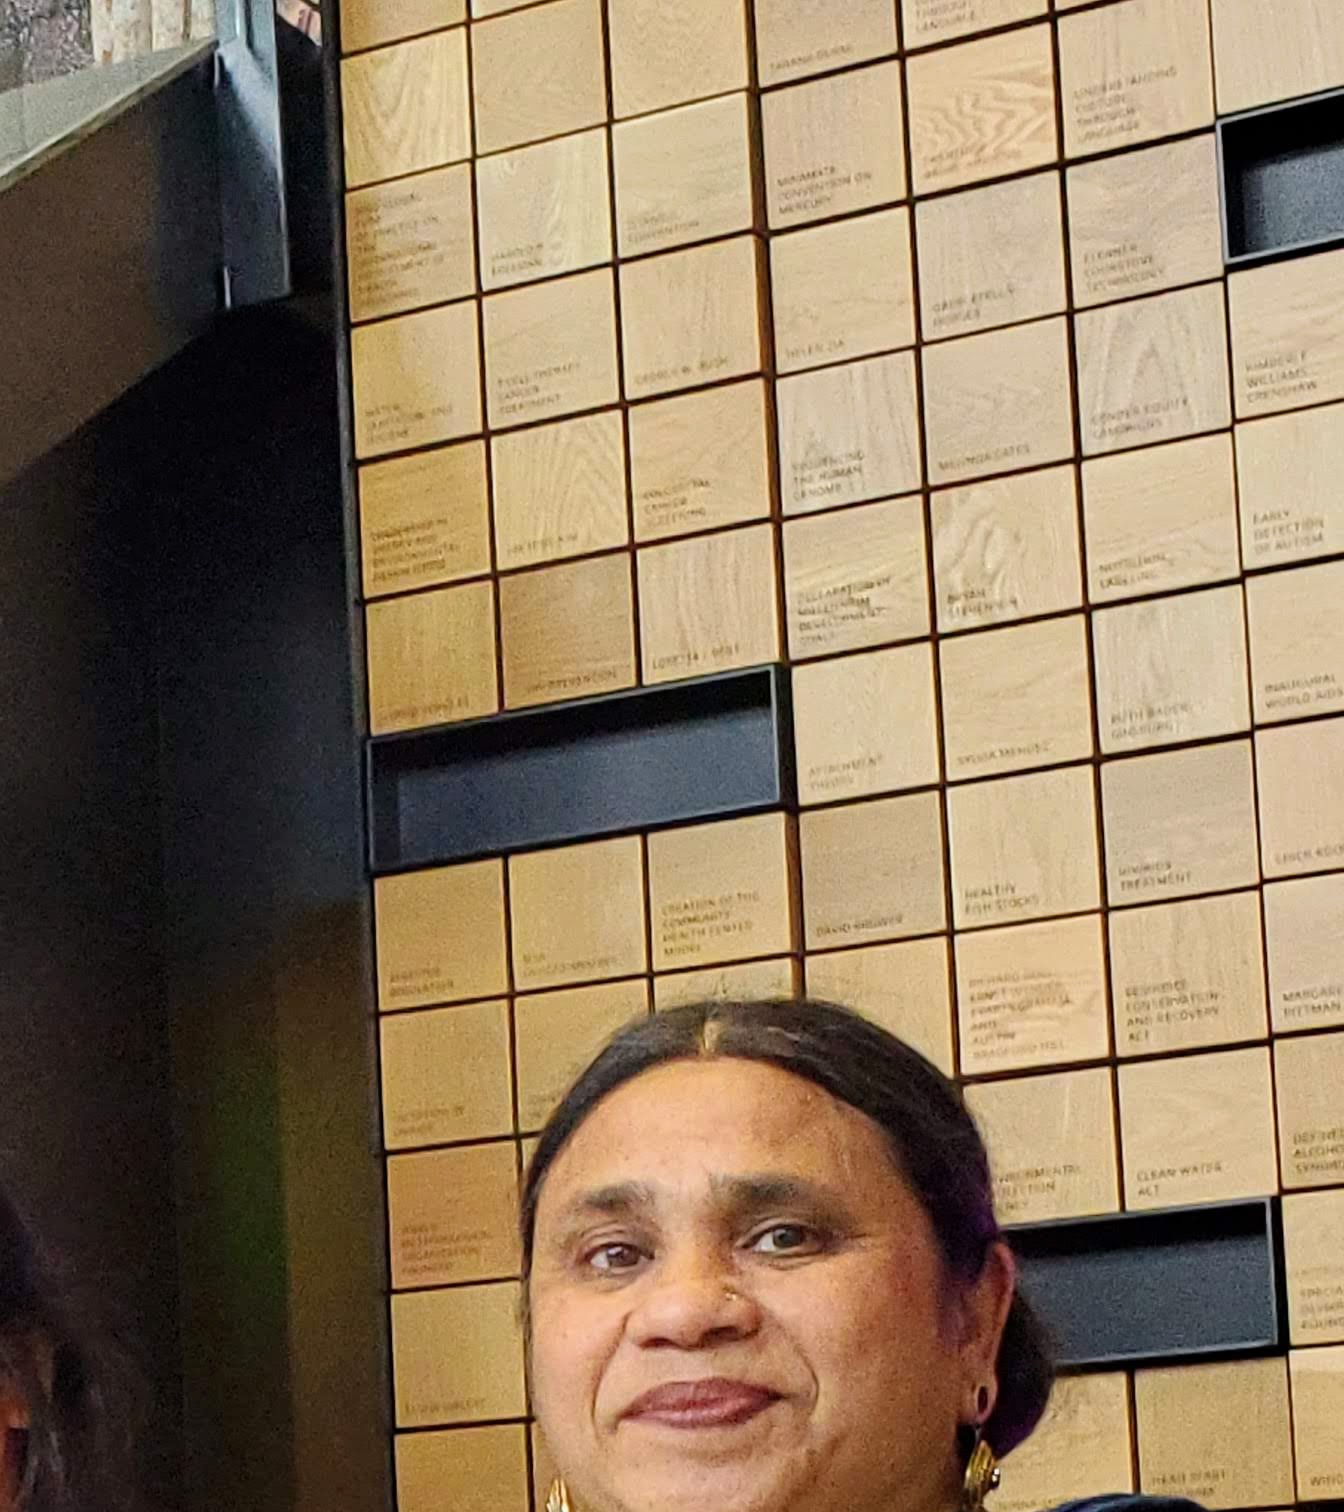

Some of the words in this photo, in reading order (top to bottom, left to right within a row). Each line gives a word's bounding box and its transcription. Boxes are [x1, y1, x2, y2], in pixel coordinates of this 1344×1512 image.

[1253, 508, 1290, 524] EARLY
[1253, 517, 1325, 539] DETECTION
[1265, 693, 1311, 708] WORLD
[1120, 871, 1192, 891] TREATMENT
[965, 884, 1016, 898] HEALTHY
[965, 900, 992, 914] FISH
[1283, 1001, 1342, 1018] PITTMAN
[1126, 1014, 1152, 1026] AND
[1128, 1029, 1149, 1041] ACT
[1137, 1168, 1175, 1182] CLEAN
[1179, 1163, 1222, 1177] WATER
[1138, 1185, 1160, 1196] ACT
